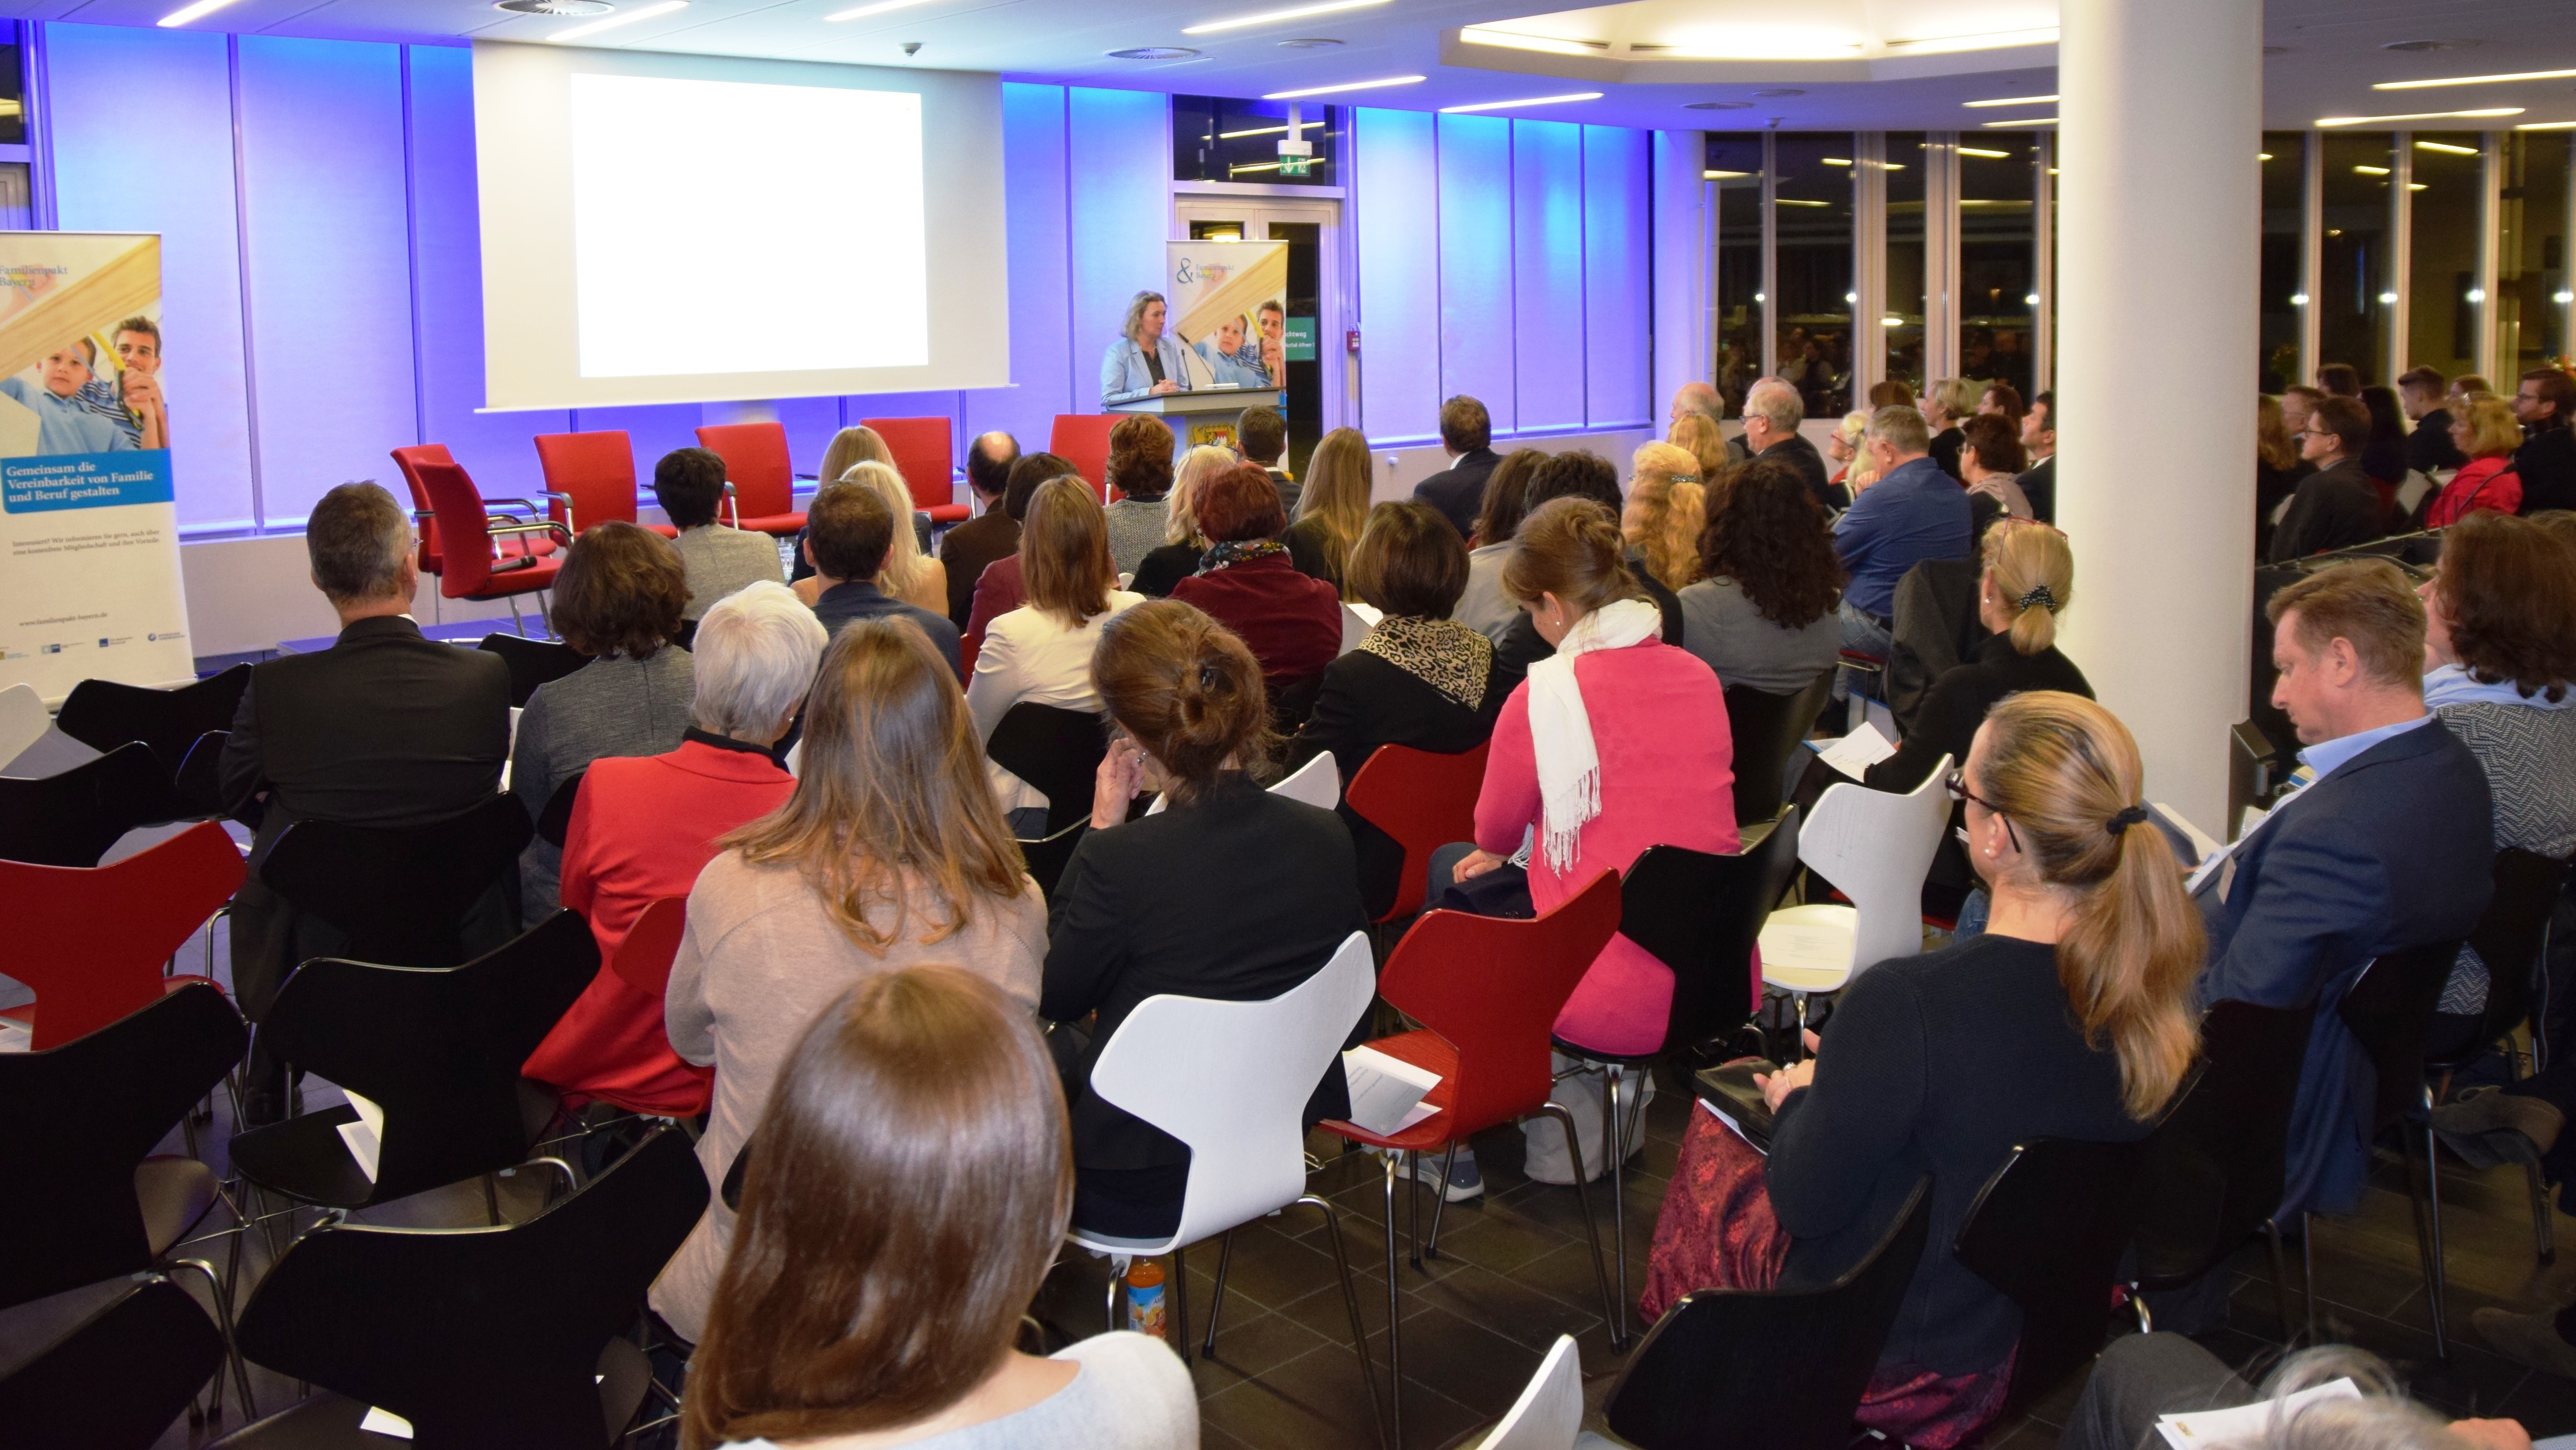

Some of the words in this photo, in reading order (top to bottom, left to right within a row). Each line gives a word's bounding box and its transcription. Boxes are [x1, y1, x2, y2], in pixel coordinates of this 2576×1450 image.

[1196, 263, 1234, 273] Familienpakt
[0, 277, 34, 288] Bayern
[6, 464, 75, 477] Gemeinsam
[78, 462, 96, 472] die
[8, 475, 85, 489] Vereinbarkeit
[88, 475, 108, 484] von
[111, 470, 154, 483] Familie
[9, 491, 31, 502] und
[35, 488, 68, 500] Beruf
[70, 486, 119, 501] gestalten
